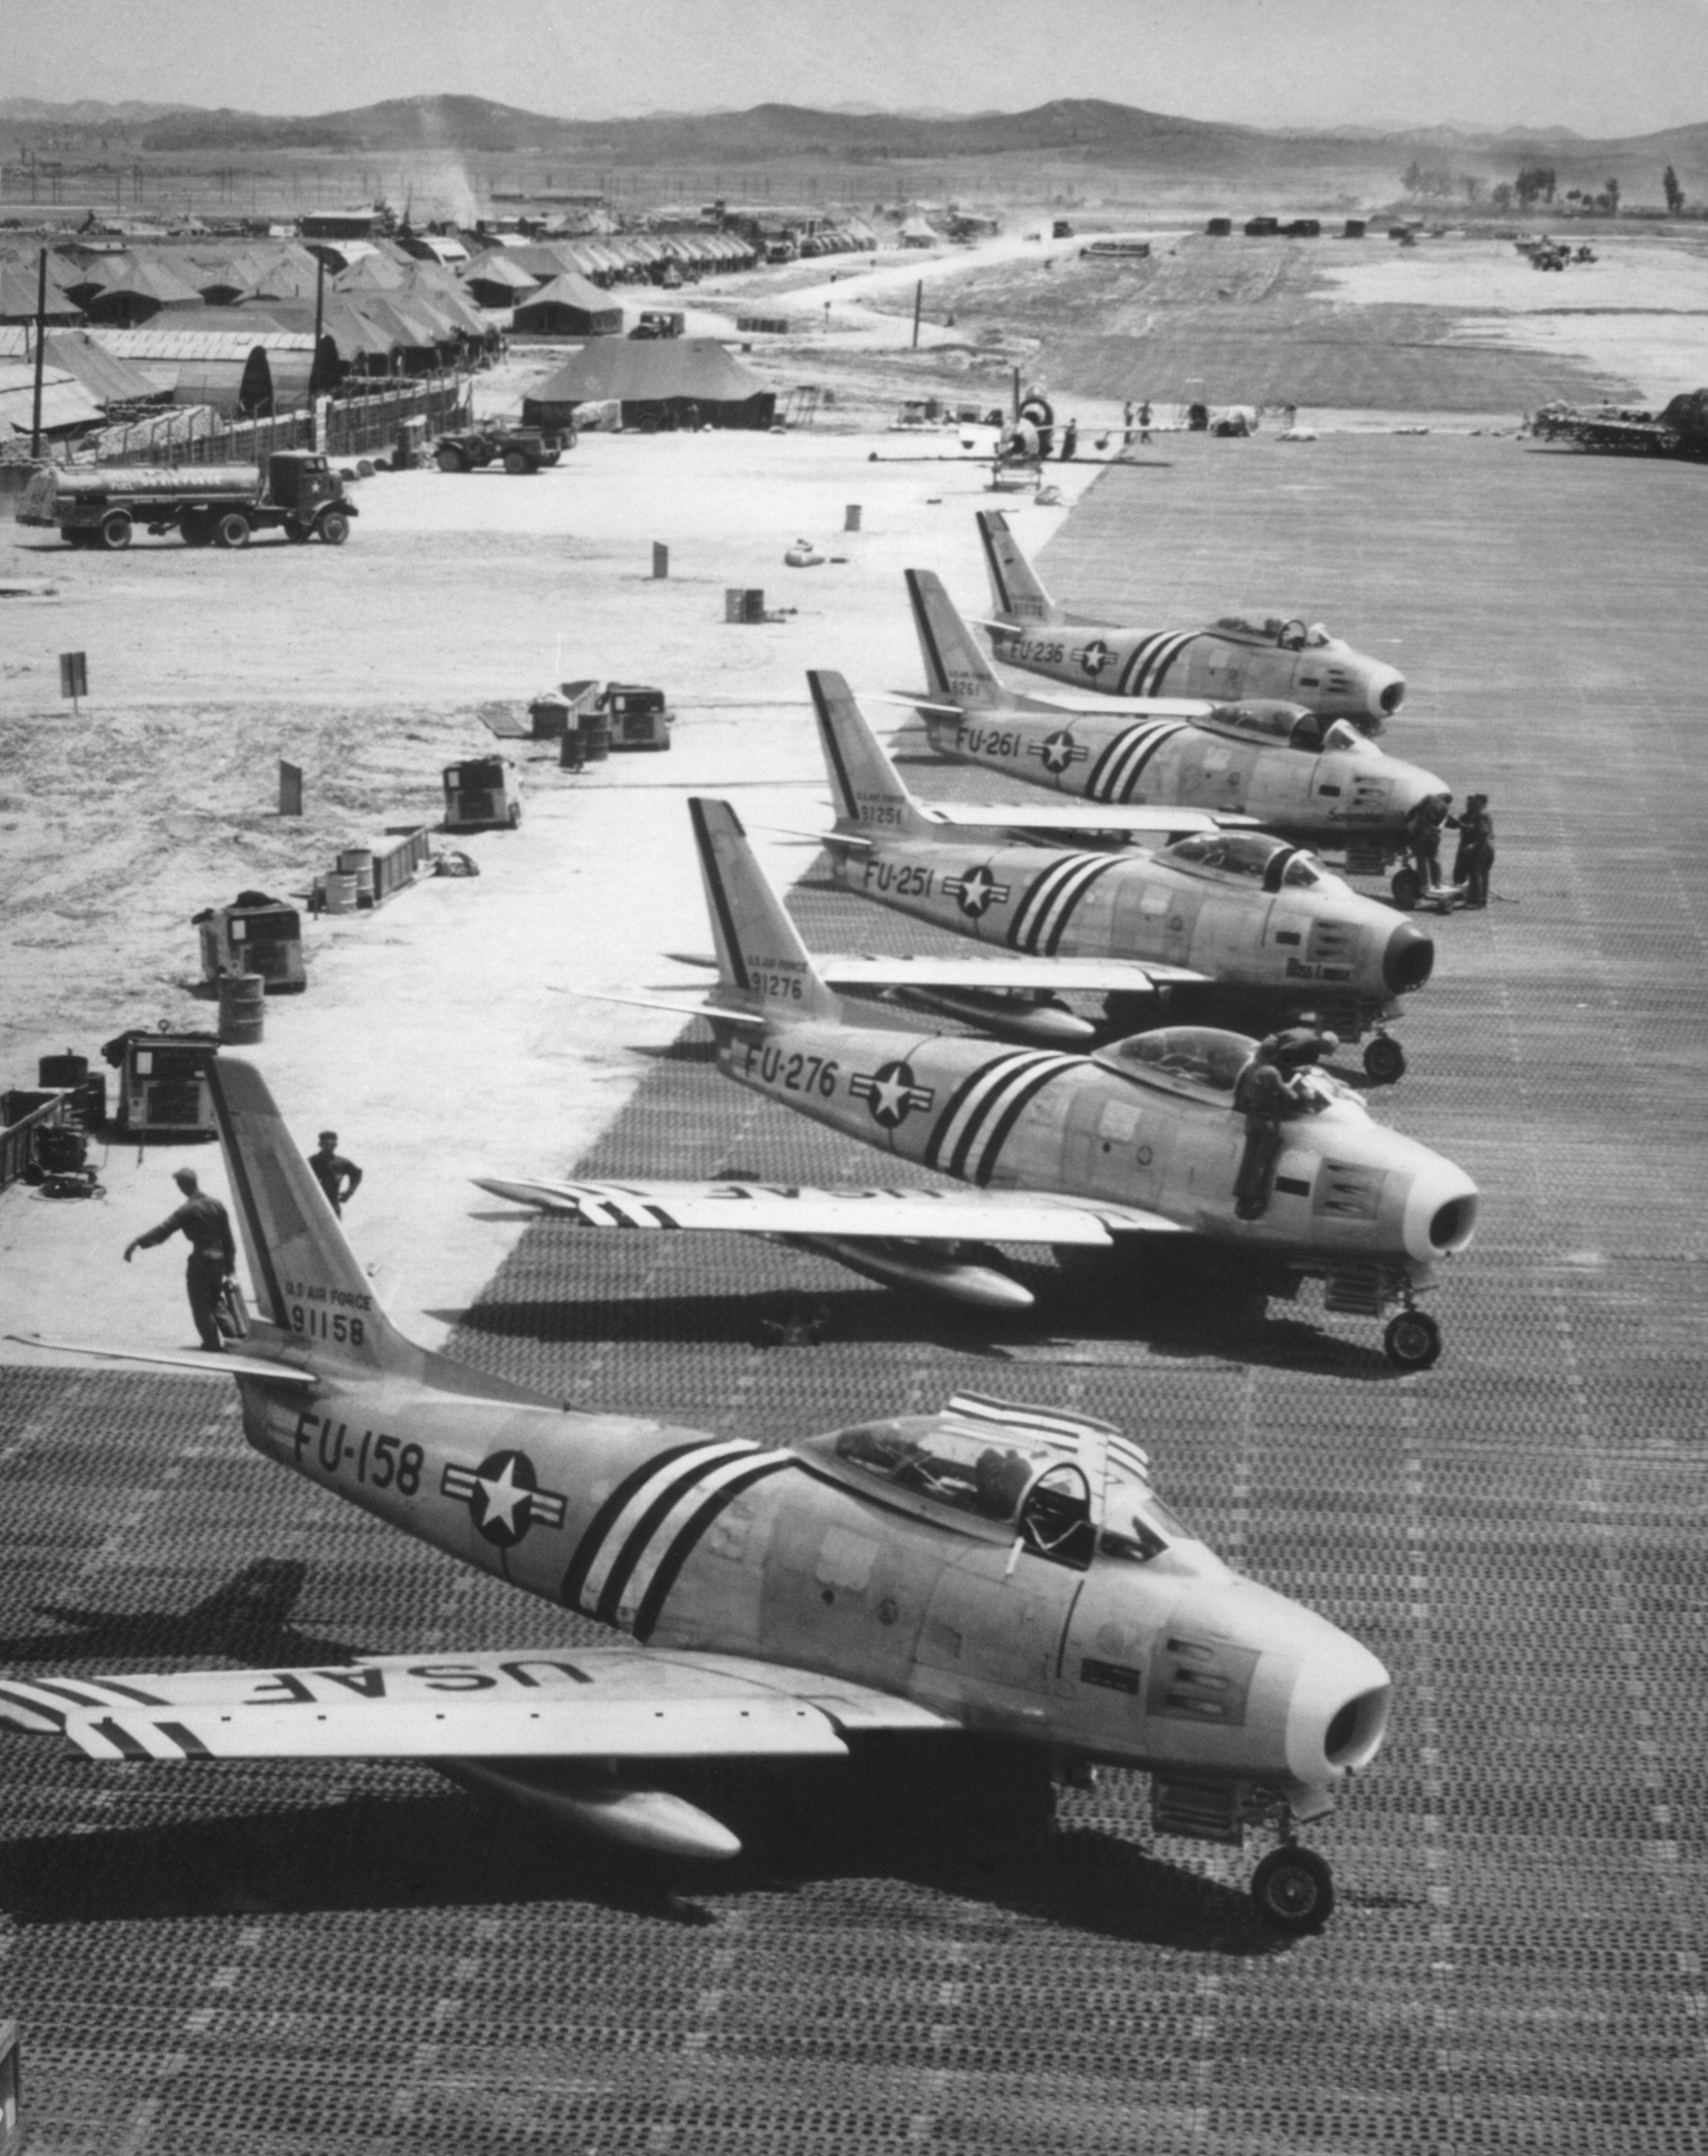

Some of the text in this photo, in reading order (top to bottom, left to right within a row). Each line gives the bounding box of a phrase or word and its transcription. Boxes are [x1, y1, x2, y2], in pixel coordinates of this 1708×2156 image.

[1010, 639, 1065, 663] FU-236
[956, 727, 1021, 757] FU-261
[862, 805, 902, 825] 91251
[864, 860, 934, 898] FU-251
[752, 971, 802, 999] 91276
[745, 1044, 839, 1097] FU-276
[308, 1285, 327, 1302] AIR
[331, 1289, 371, 1312] FORCE
[292, 1305, 364, 1346] 91158
[295, 1412, 424, 1496] FU-158
[241, 1660, 595, 1705] USAF
